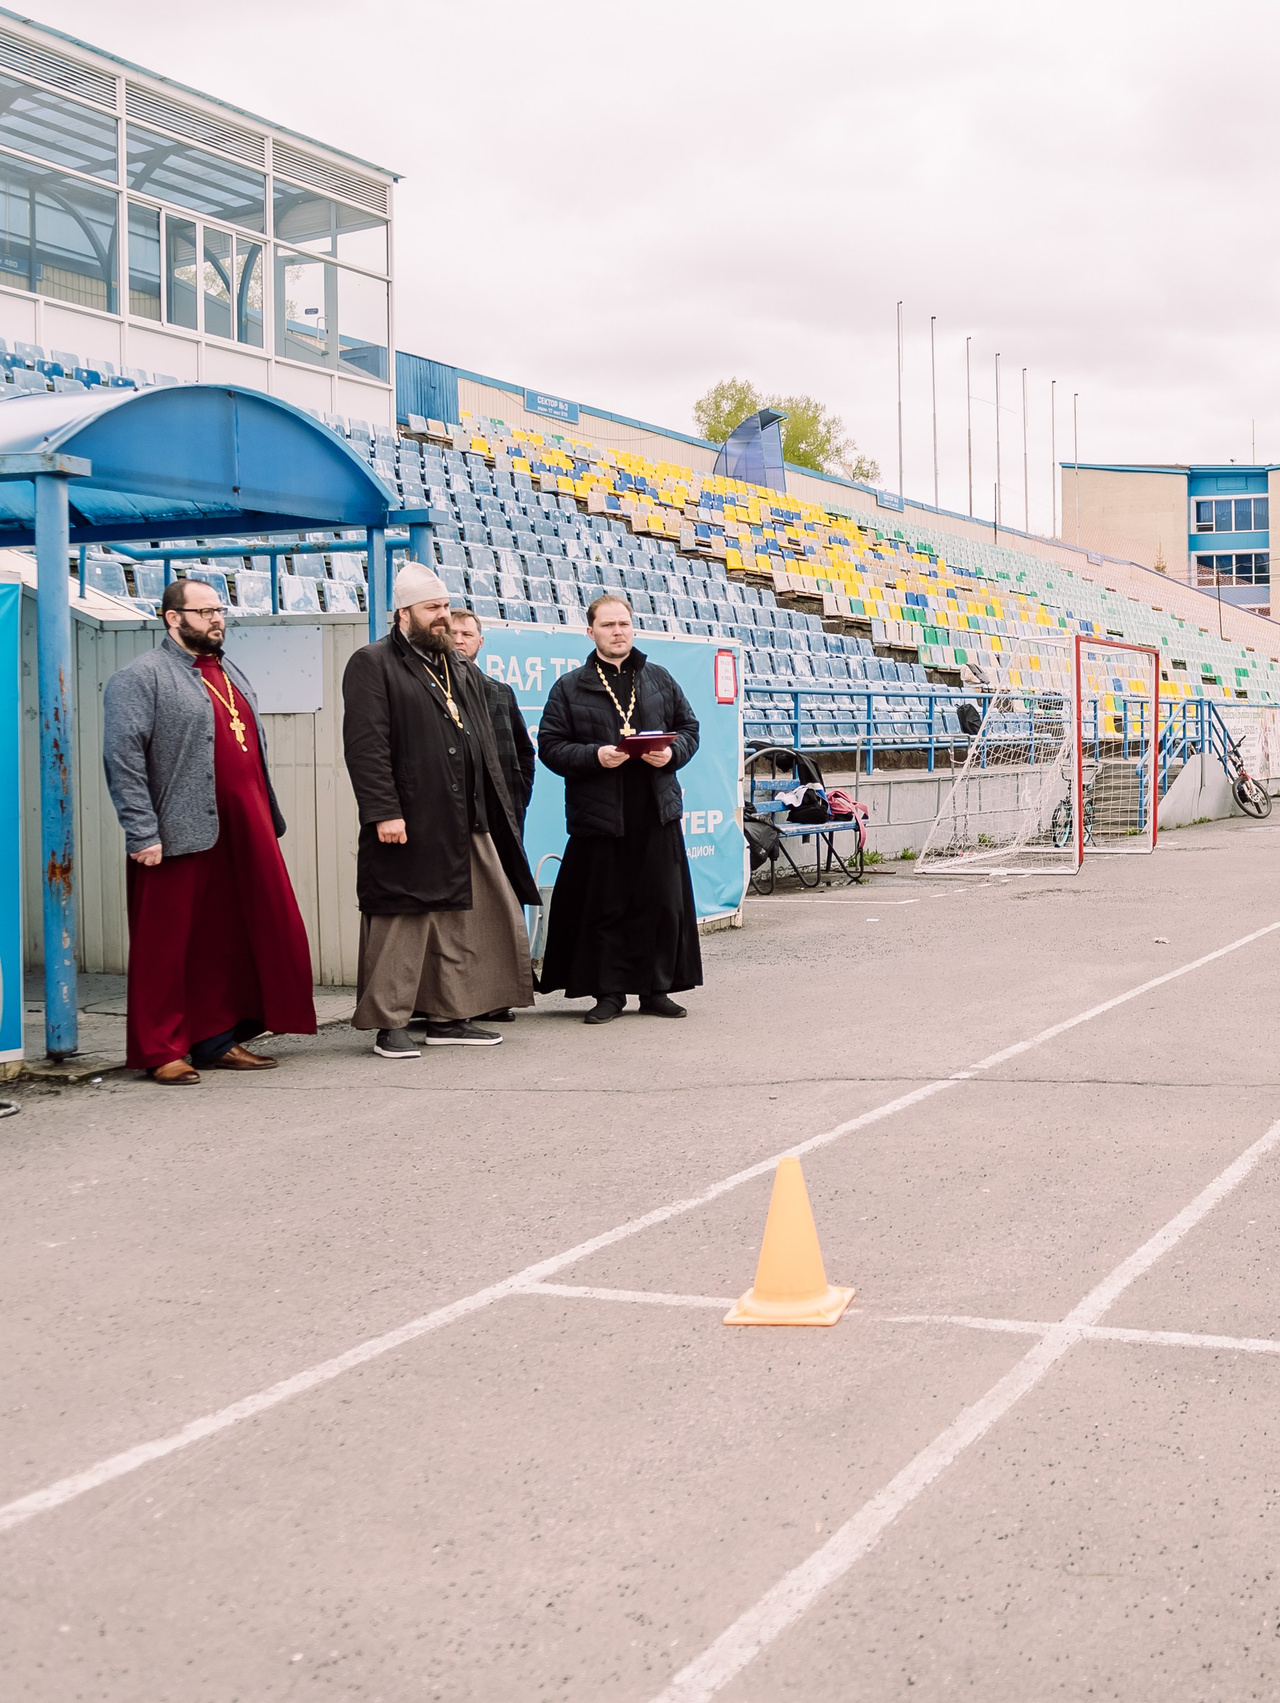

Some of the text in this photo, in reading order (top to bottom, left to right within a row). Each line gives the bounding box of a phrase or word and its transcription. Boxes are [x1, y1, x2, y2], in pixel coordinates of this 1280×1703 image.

[537, 396, 558, 408] СЕКТОР
[475, 654, 542, 691] ВАЯ
[680, 809, 723, 836] ТЕР
[685, 845, 715, 859] АДИОН
